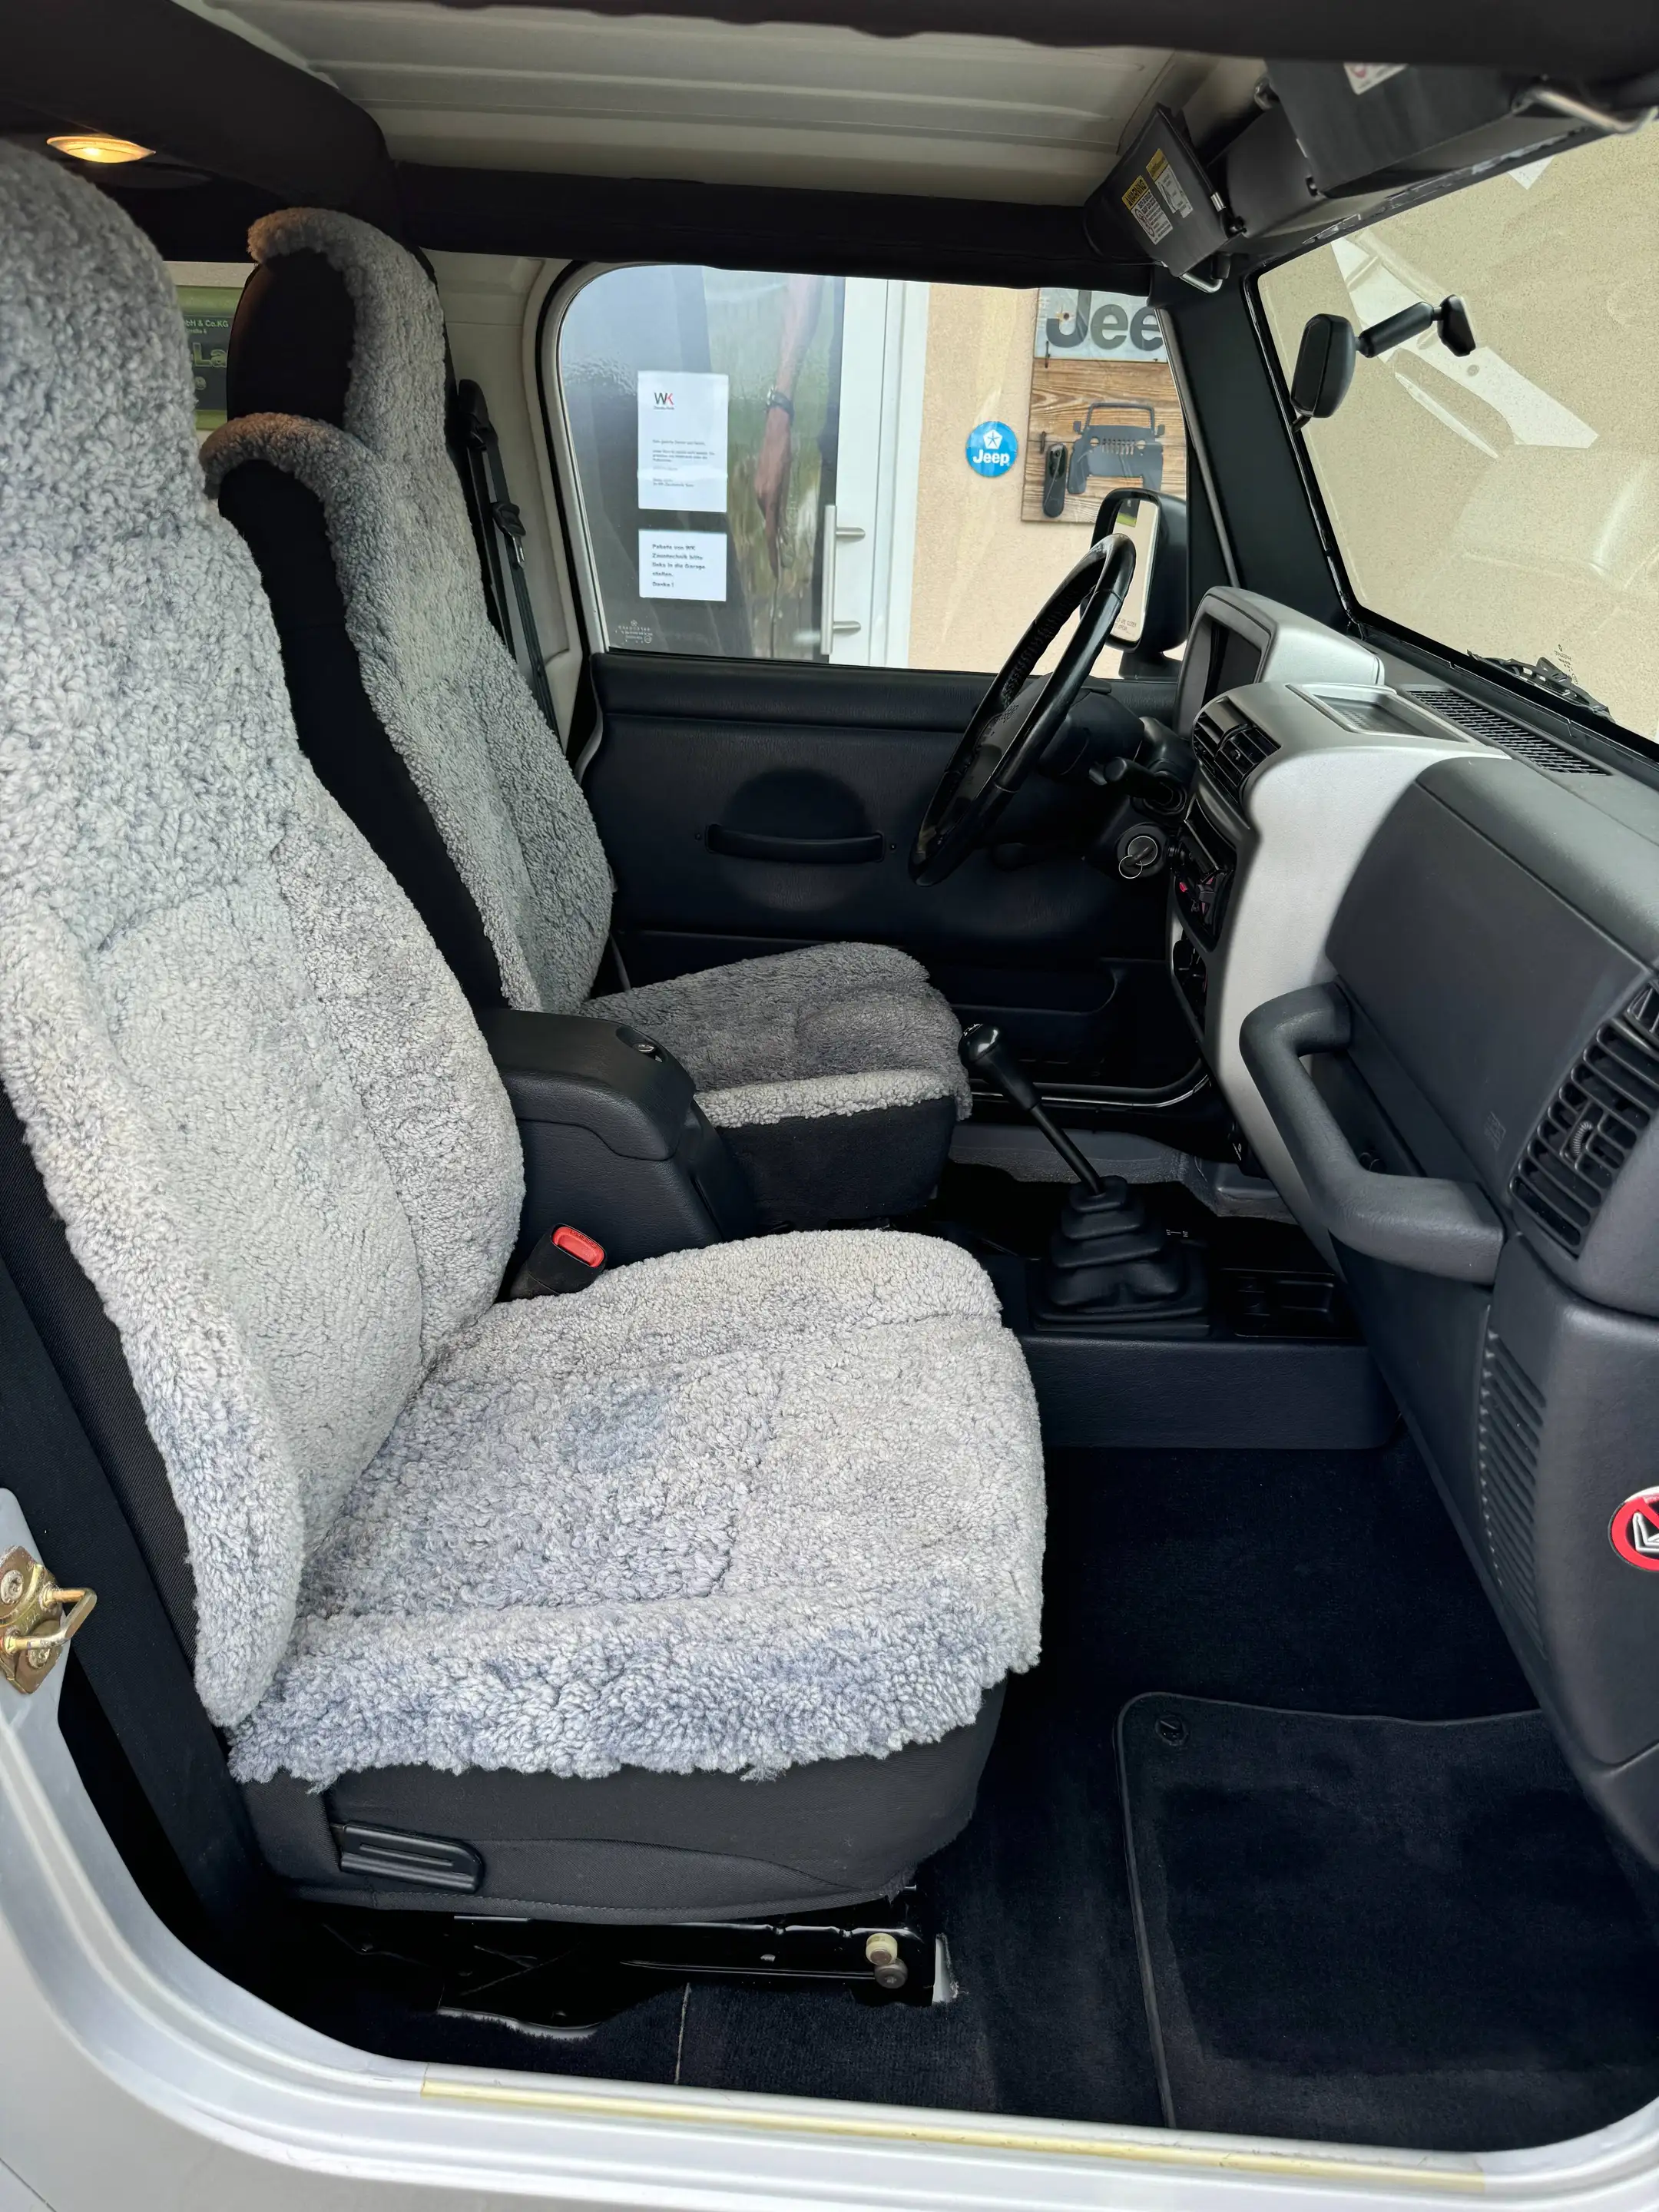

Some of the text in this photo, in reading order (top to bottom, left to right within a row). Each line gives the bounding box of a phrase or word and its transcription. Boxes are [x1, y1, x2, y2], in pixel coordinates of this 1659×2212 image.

[1127, 179, 1147, 205] WARNING
[654, 392, 674, 406] WK
[972, 449, 1010, 467] Jeep
